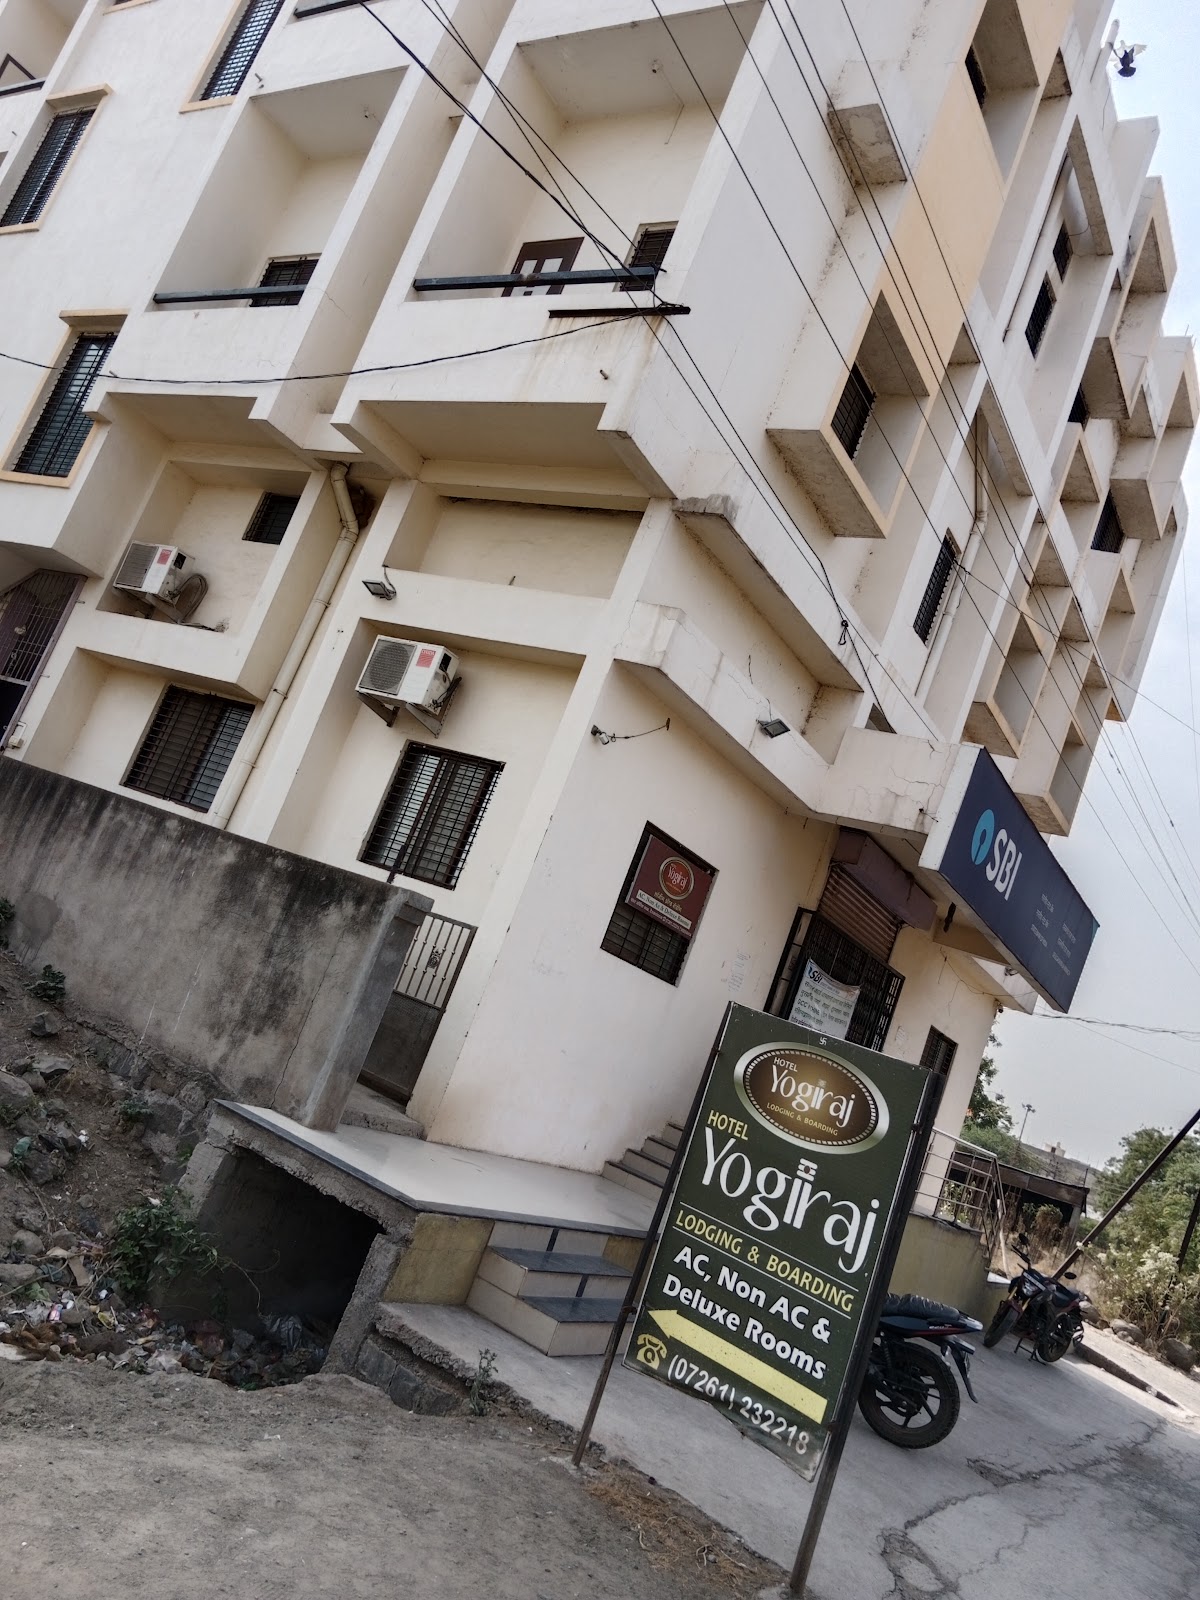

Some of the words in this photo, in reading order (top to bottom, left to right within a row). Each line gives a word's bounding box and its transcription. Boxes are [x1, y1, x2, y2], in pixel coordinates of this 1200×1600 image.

[986, 828, 1022, 900] SBI
[771, 1064, 856, 1128] Yogiraj
[774, 1057, 798, 1073] HOTEL
[707, 1110, 749, 1141] HOTEL
[766, 1102, 795, 1119] LODGING
[796, 1113, 802, 1122] &
[803, 1117, 839, 1137] BOARDING
[700, 1126, 881, 1274] Yogiraj
[673, 1245, 712, 1283] AC,
[717, 1265, 767, 1308] Non
[769, 1296, 810, 1330] AC
[812, 1317, 831, 1344] &
[675, 1210, 743, 1255] LODGING
[747, 1245, 760, 1264] &
[766, 1254, 855, 1312] BOARDING
[662, 1274, 742, 1332] Deluxe
[743, 1317, 828, 1380] Rooms
[667, 1354, 736, 1410] (07261)
[739, 1396, 810, 1455] 232218
